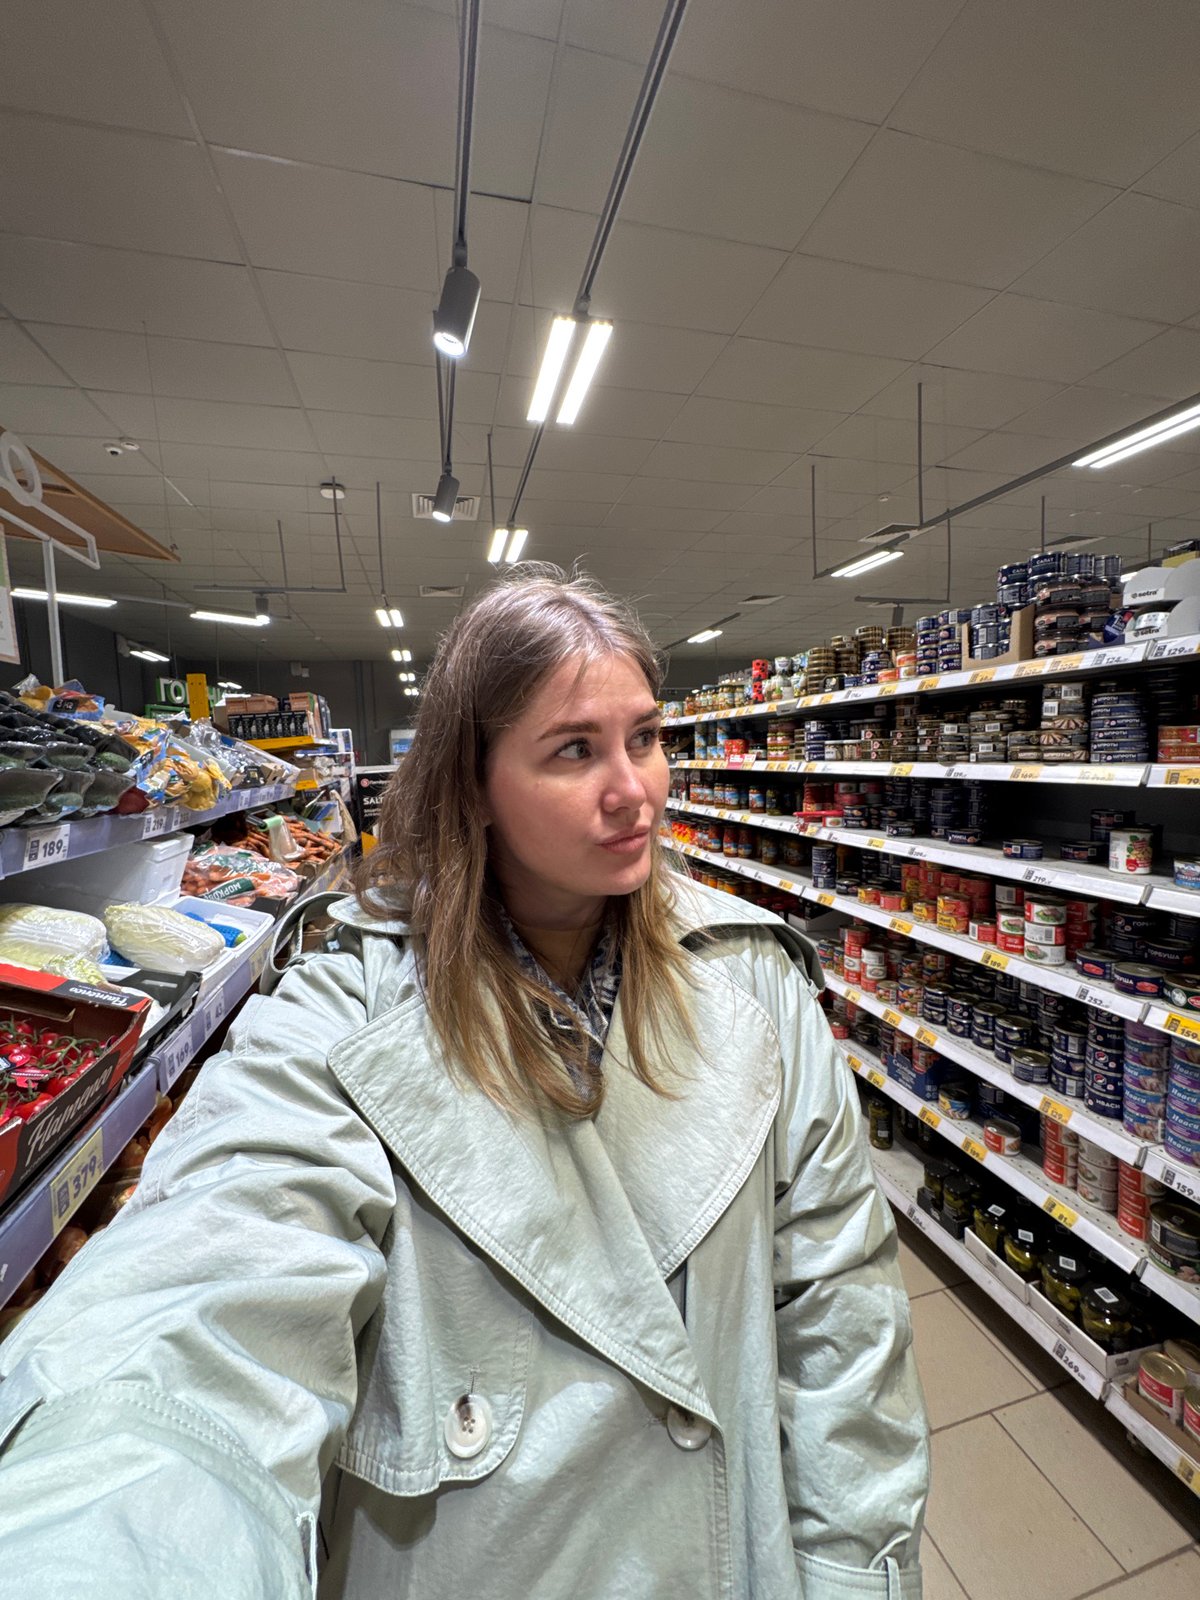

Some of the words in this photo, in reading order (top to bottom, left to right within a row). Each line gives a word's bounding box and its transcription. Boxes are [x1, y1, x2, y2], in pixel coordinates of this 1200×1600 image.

[152, 818, 164, 832] 219
[42, 838, 63, 858] 189
[1146, 948, 1180, 961] ГОРБУША
[69, 986, 129, 1007] Flamenco
[25, 1064, 114, 1167] Flamenco
[72, 1154, 98, 1200] 379
